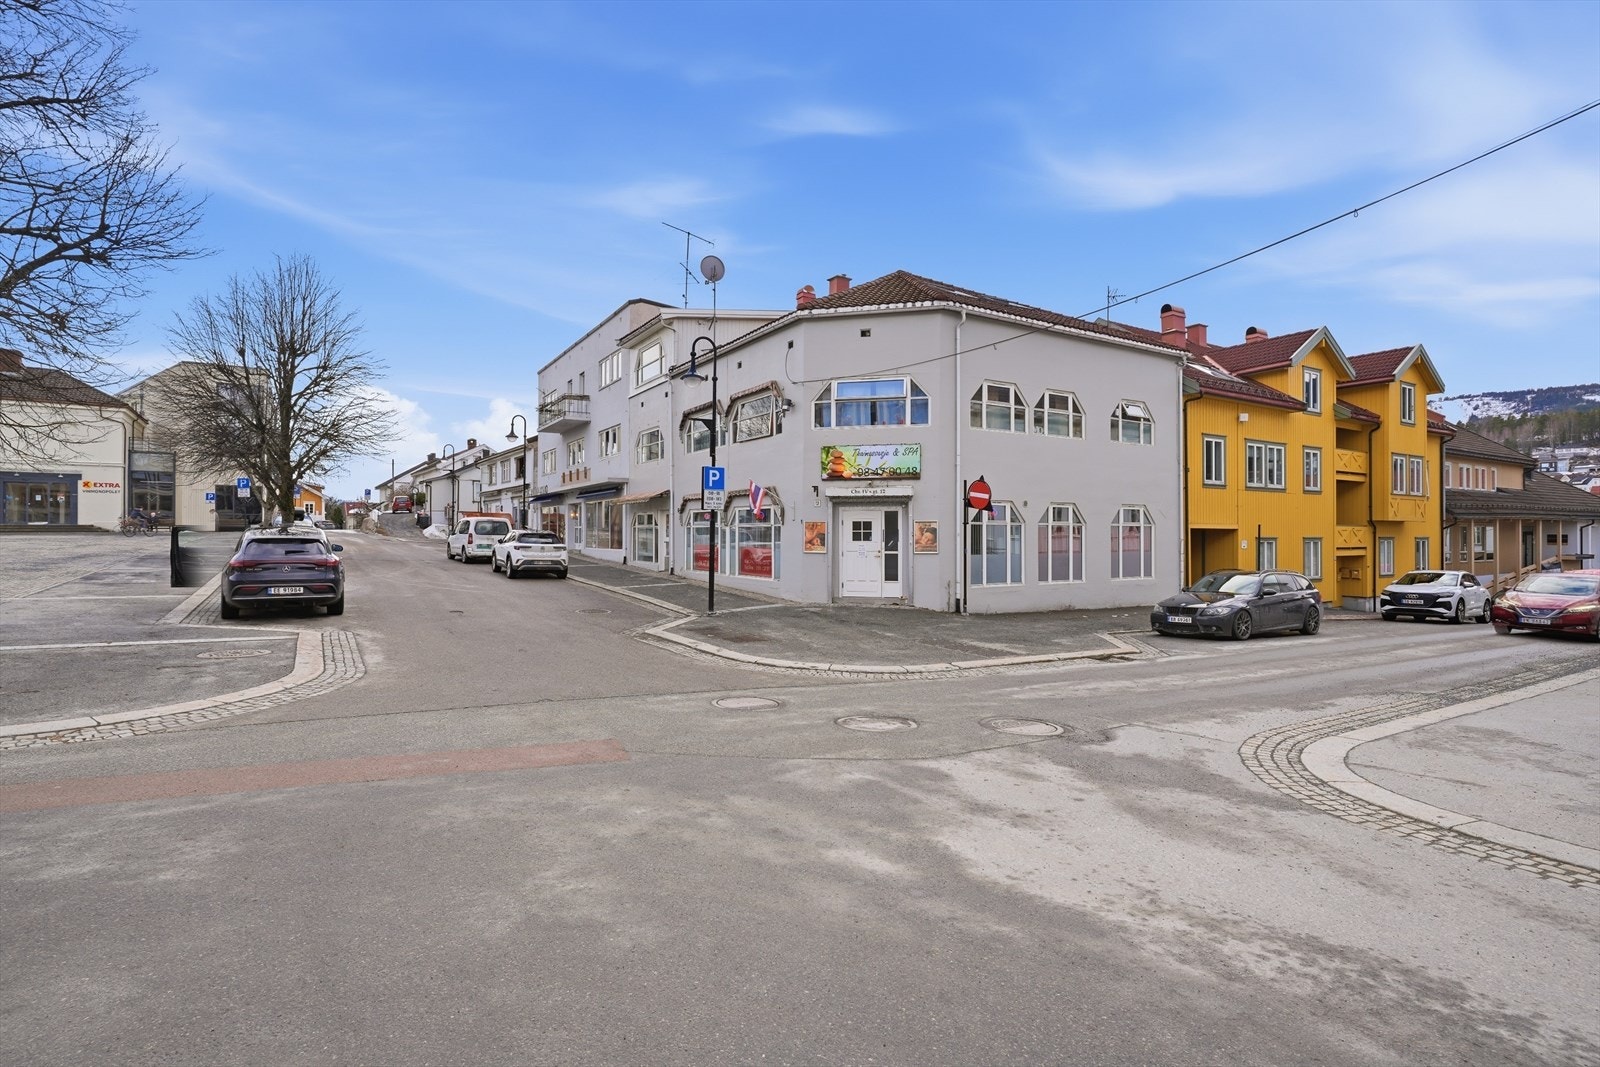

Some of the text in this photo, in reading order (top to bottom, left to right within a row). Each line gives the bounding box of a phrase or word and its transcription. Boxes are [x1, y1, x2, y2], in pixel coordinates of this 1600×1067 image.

[893, 448, 899, 457] &
[902, 447, 919, 457] SPA
[857, 467, 870, 477] 98
[905, 466, 918, 476] 48
[709, 469, 720, 487] P
